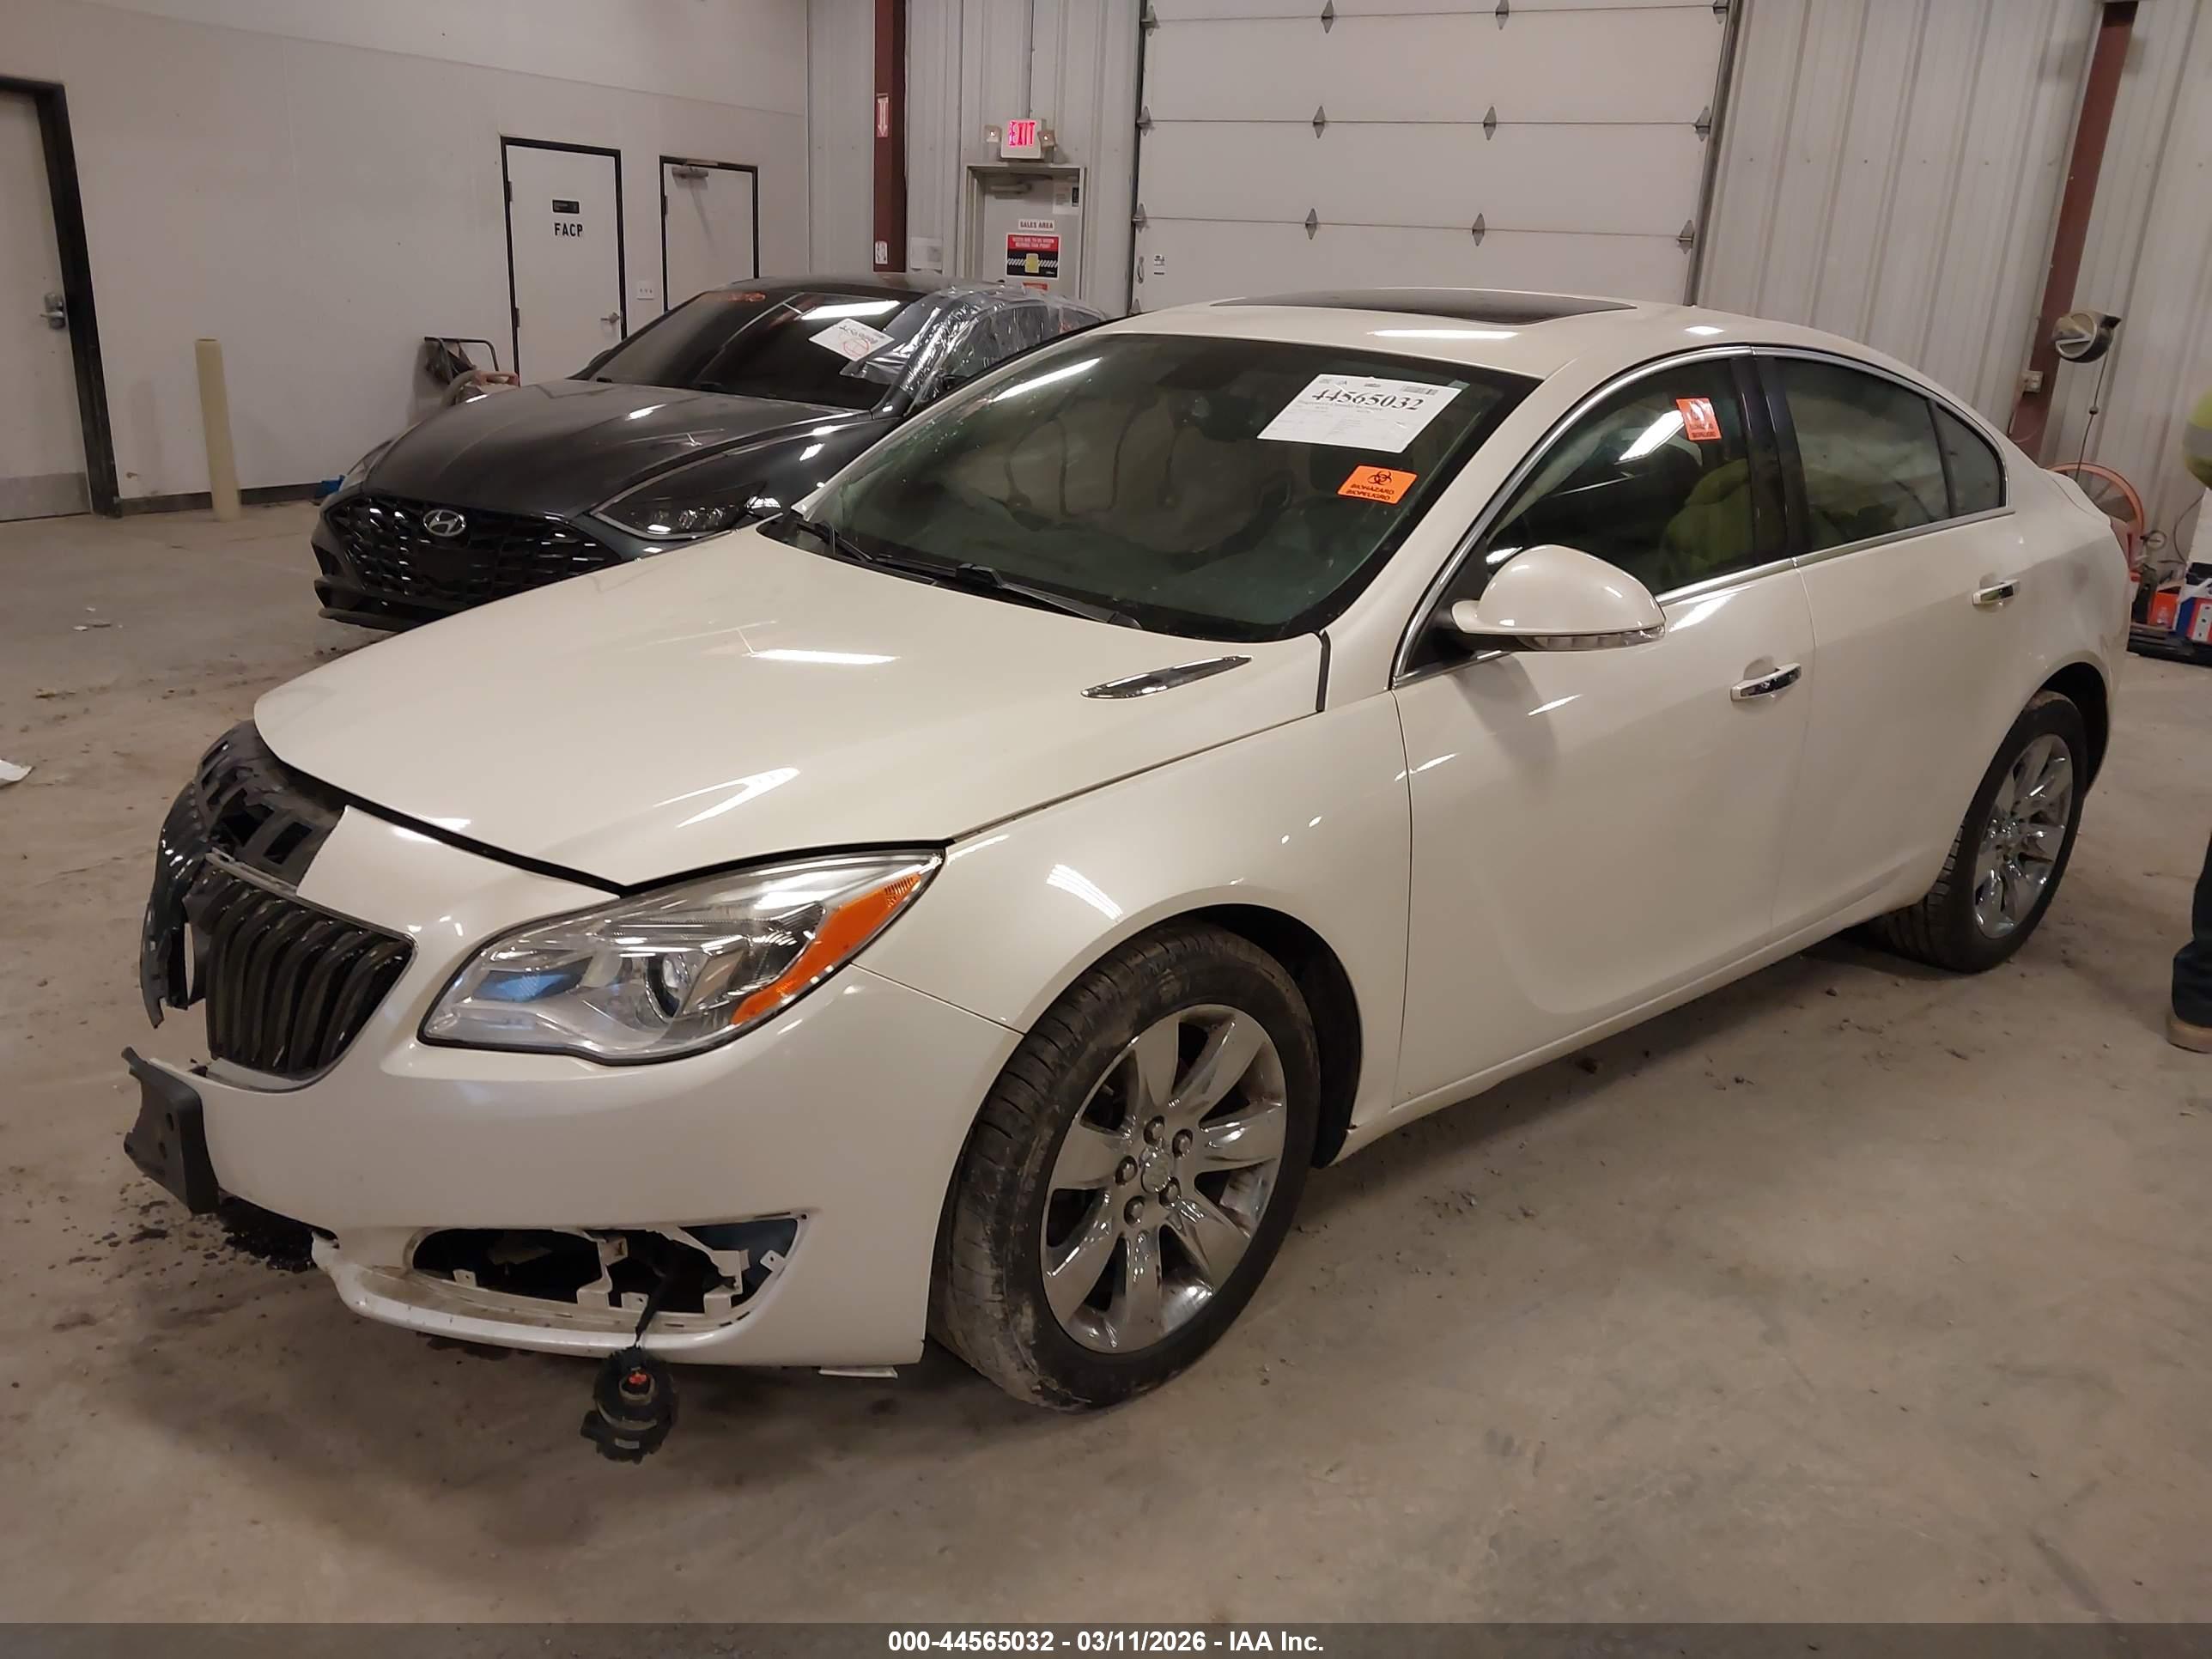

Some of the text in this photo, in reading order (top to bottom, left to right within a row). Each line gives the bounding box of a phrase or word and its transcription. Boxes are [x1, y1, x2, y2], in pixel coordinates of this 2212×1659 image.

[1009, 121, 1036, 146] EXIT
[554, 222, 583, 237] FACP
[1020, 221, 1037, 229] SALES
[1312, 388, 1424, 410] 44565032
[1346, 489, 1390, 500] BIOPELIGRO
[1351, 484, 1395, 495] BIOHAZARD
